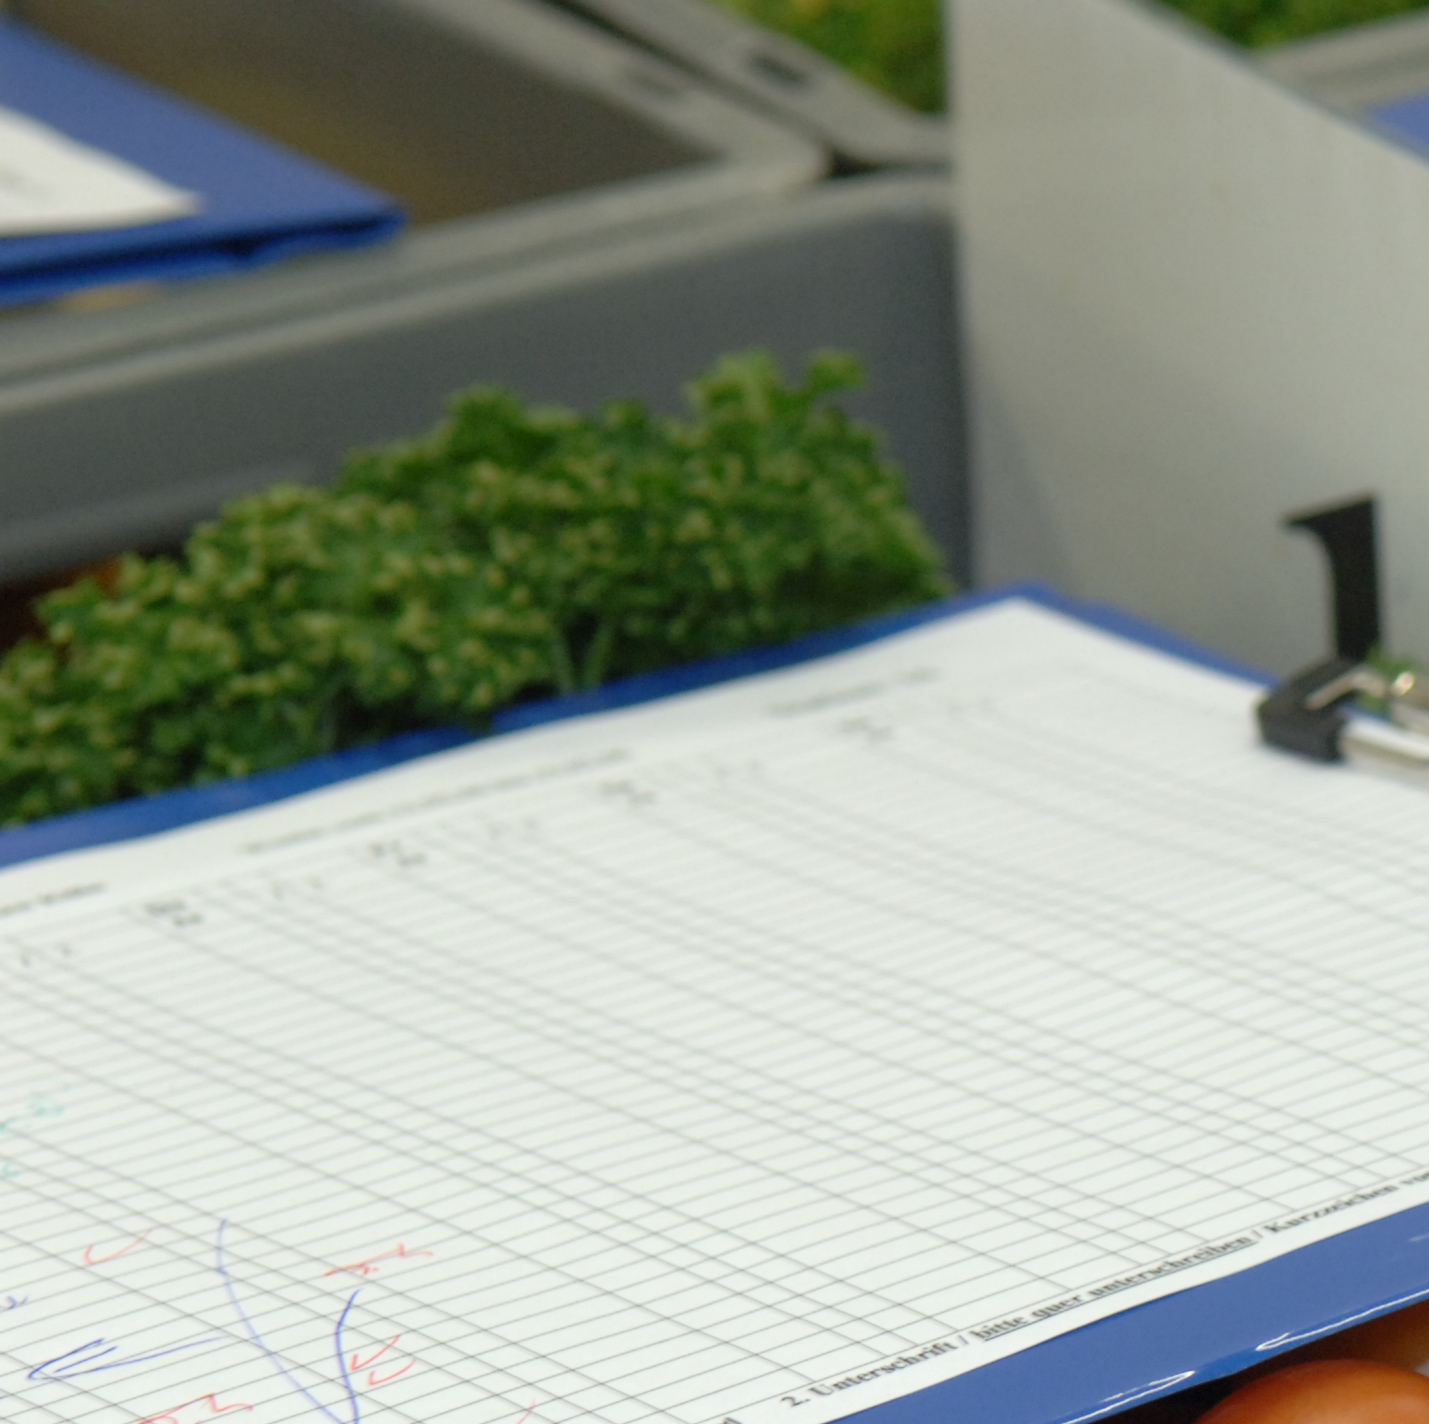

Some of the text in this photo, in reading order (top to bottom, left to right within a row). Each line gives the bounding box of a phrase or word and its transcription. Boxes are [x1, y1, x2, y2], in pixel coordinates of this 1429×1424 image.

[810, 1340, 959, 1397] Unterschrift
[969, 1315, 1028, 1341] bitte
[1031, 1293, 1083, 1320] quer
[1088, 1233, 1257, 1297] unterschreiben
